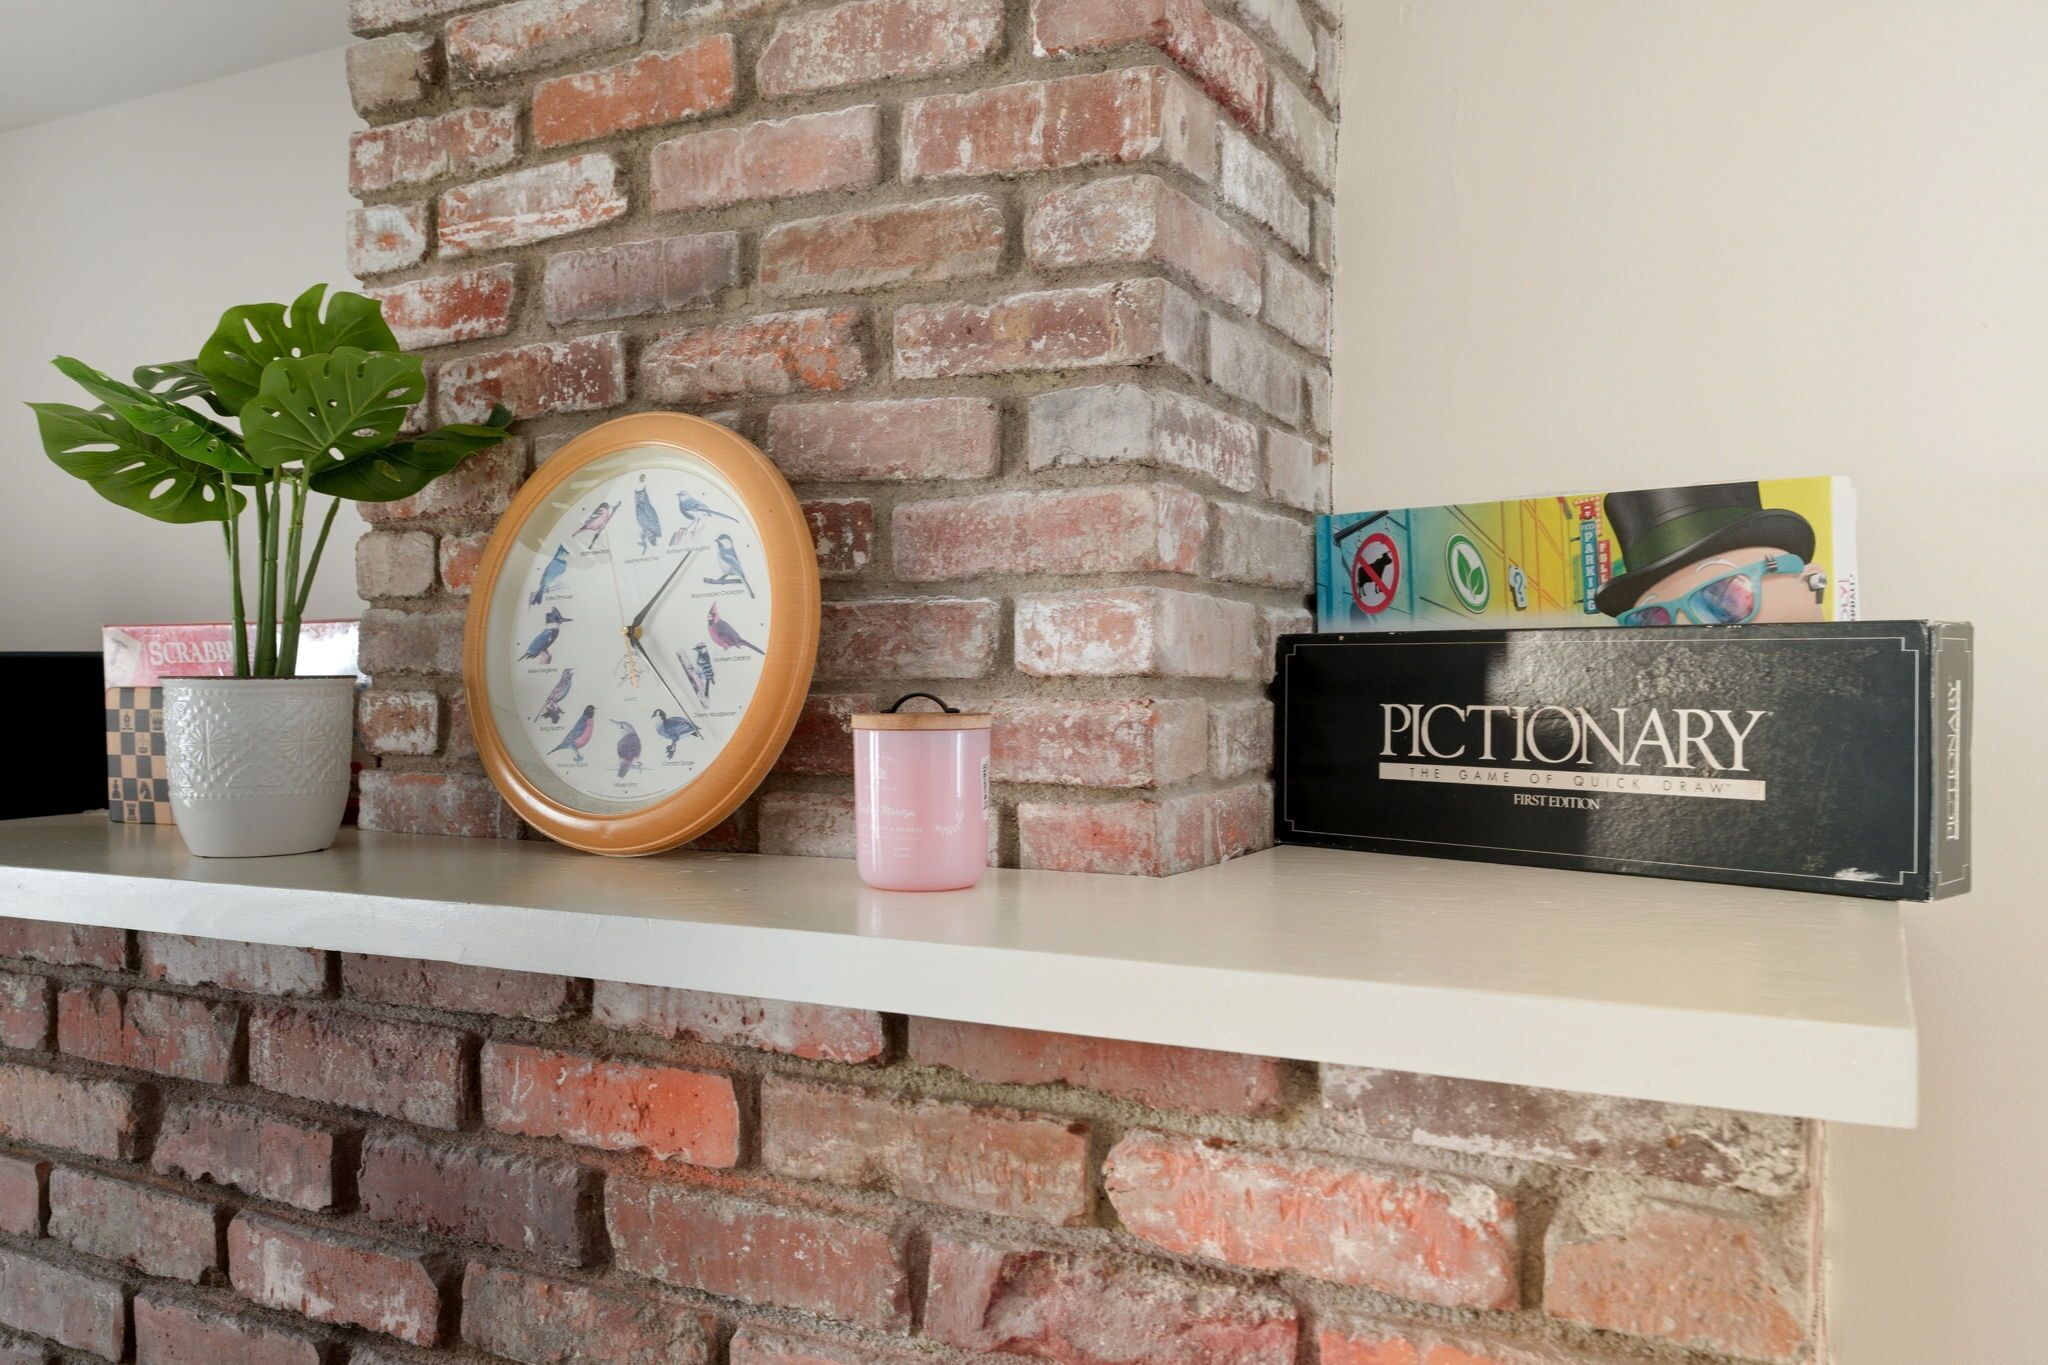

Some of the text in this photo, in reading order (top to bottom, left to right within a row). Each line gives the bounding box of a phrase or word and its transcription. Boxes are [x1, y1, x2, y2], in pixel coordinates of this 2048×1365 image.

[1584, 532, 1596, 610] PARKING
[1379, 703, 1766, 772] PICTIONARY
[1409, 767, 1440, 779] THE
[1459, 769, 1510, 783] GAME
[1528, 773, 1553, 785] OF
[1573, 775, 1641, 790] QUICK
[1513, 793, 1601, 811] FIRST EDITION
